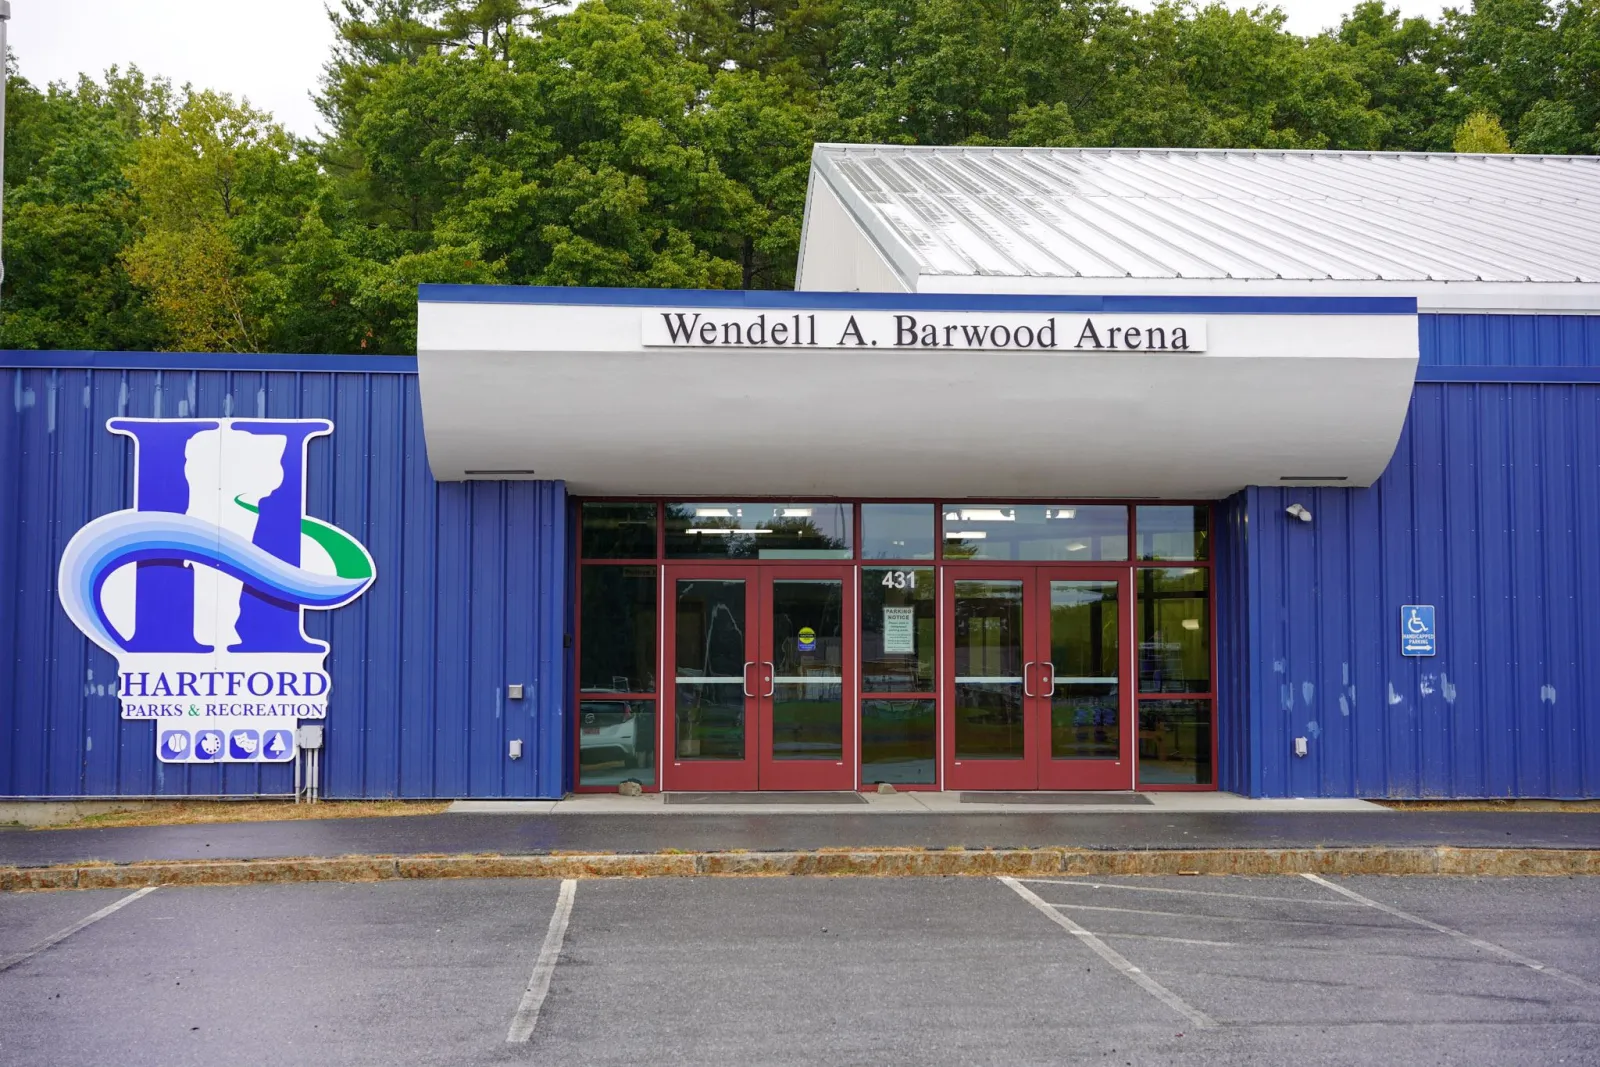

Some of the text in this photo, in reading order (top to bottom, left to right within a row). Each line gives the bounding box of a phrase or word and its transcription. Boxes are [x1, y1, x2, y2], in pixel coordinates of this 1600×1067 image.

[662, 313, 1190, 350] Wendell A. Barwood Arena
[882, 571, 915, 589] 431
[122, 671, 328, 697] HARTFORD
[126, 703, 323, 717] PARKS & RECREATION
